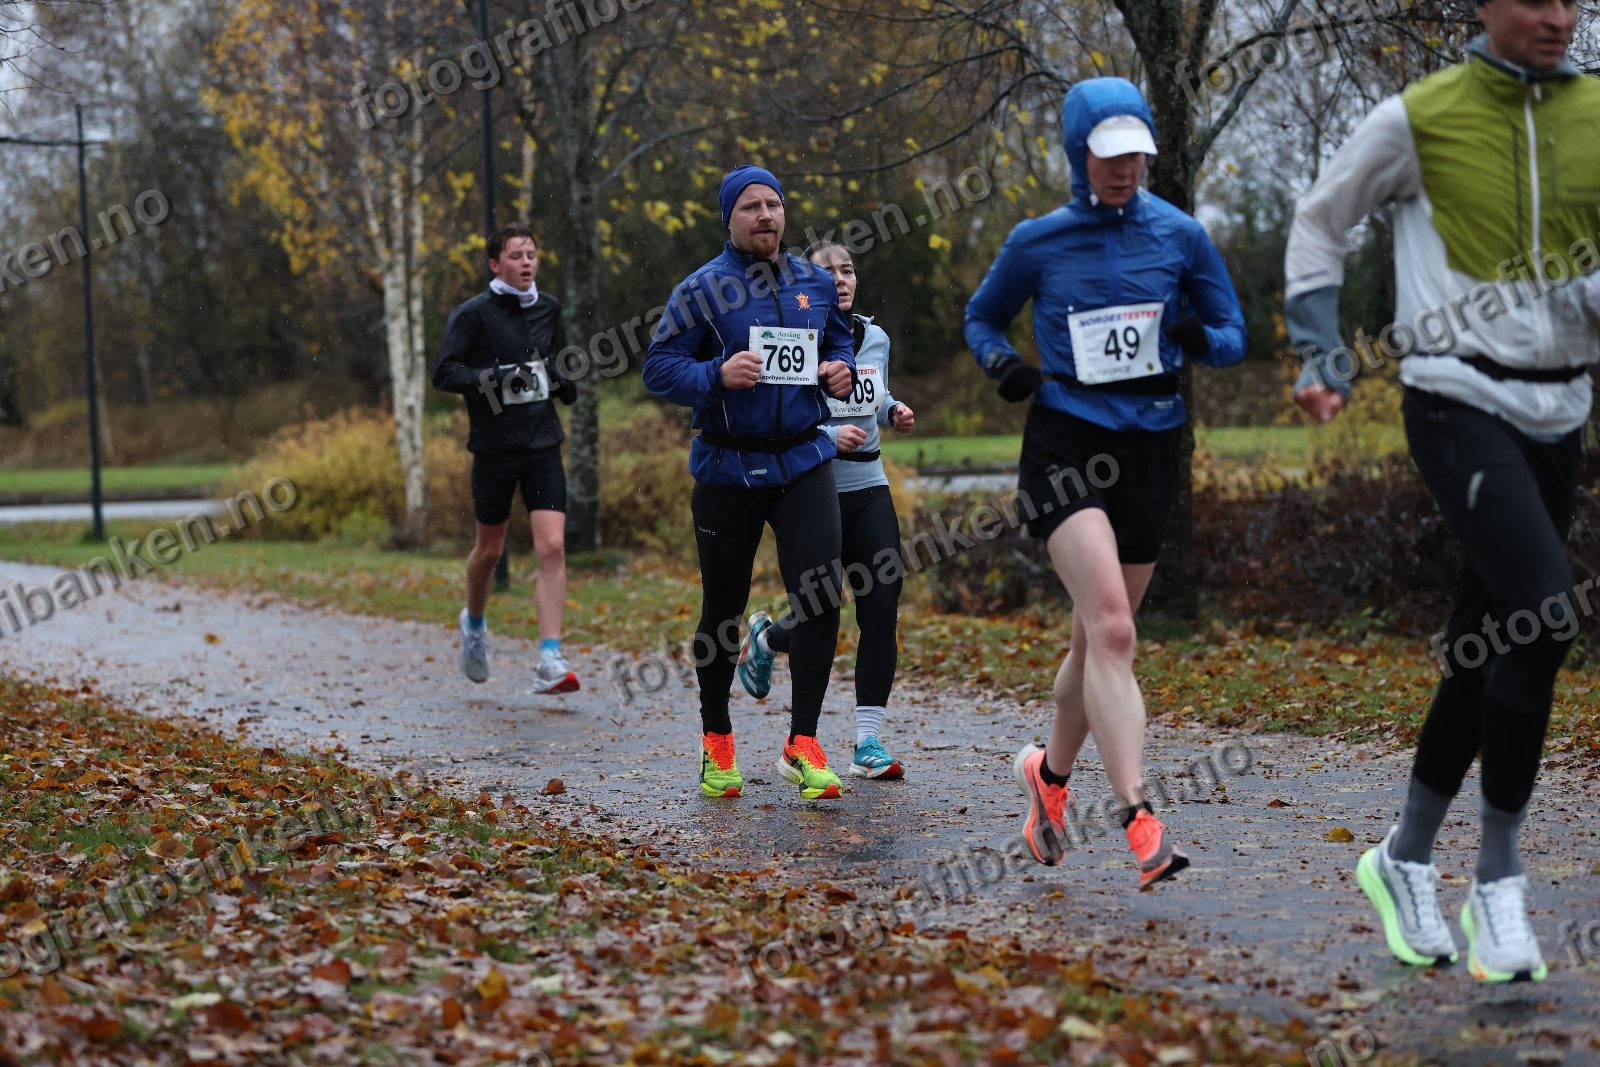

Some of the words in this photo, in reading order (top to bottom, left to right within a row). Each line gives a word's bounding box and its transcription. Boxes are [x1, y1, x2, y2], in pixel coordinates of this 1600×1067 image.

[1104, 326, 1140, 361] 49
[763, 345, 805, 373] 769
[846, 378, 875, 405] 09
